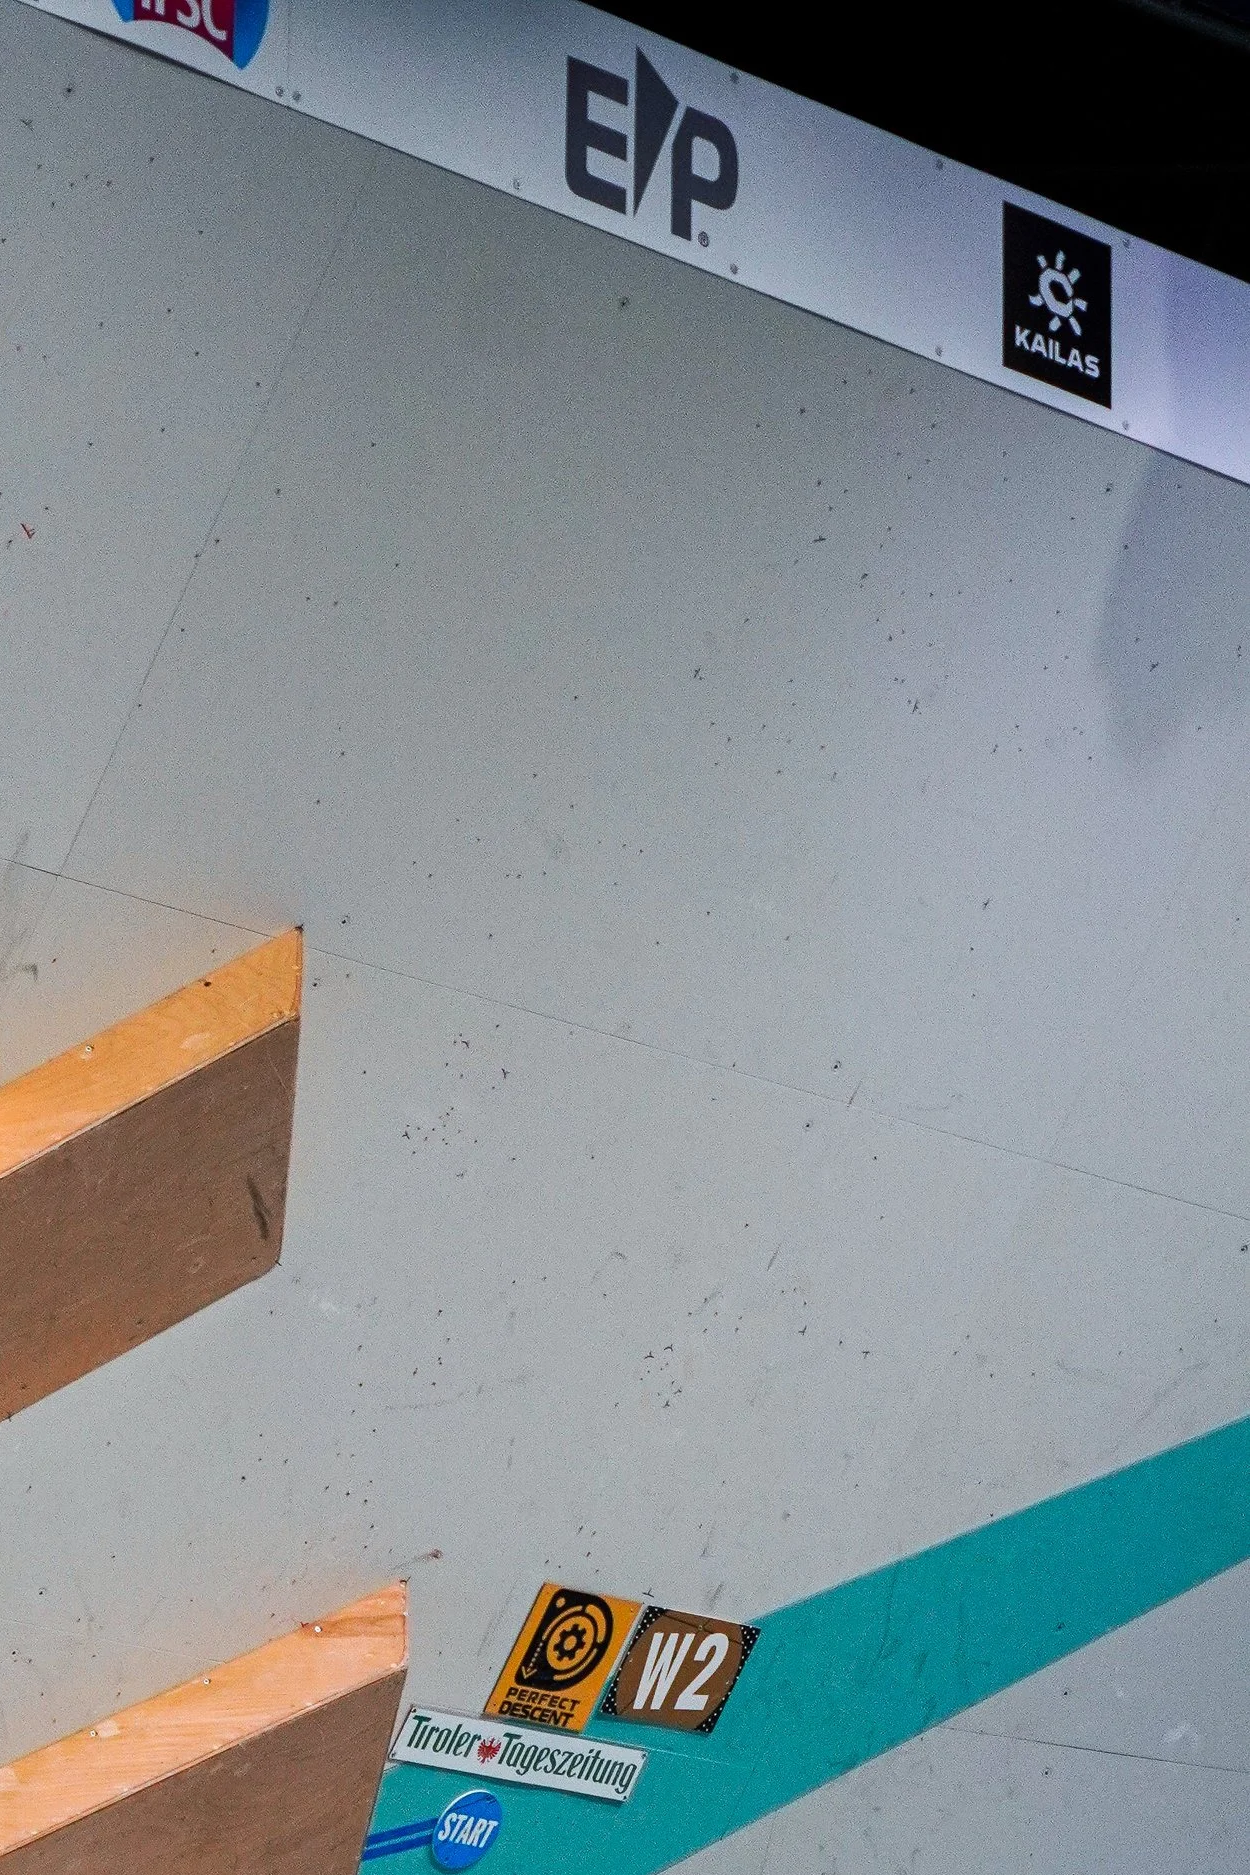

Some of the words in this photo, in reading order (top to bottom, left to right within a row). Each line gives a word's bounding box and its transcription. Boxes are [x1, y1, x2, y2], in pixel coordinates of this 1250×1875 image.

[1015, 324, 1100, 378] KAILAS
[633, 1632, 730, 1711] W2
[498, 1701, 574, 1727] DESCENT
[505, 1687, 580, 1711] PERFECT
[407, 1715, 481, 1758] Tiroler
[498, 1732, 638, 1795] Tageszeitung
[438, 1812, 499, 1848] START
